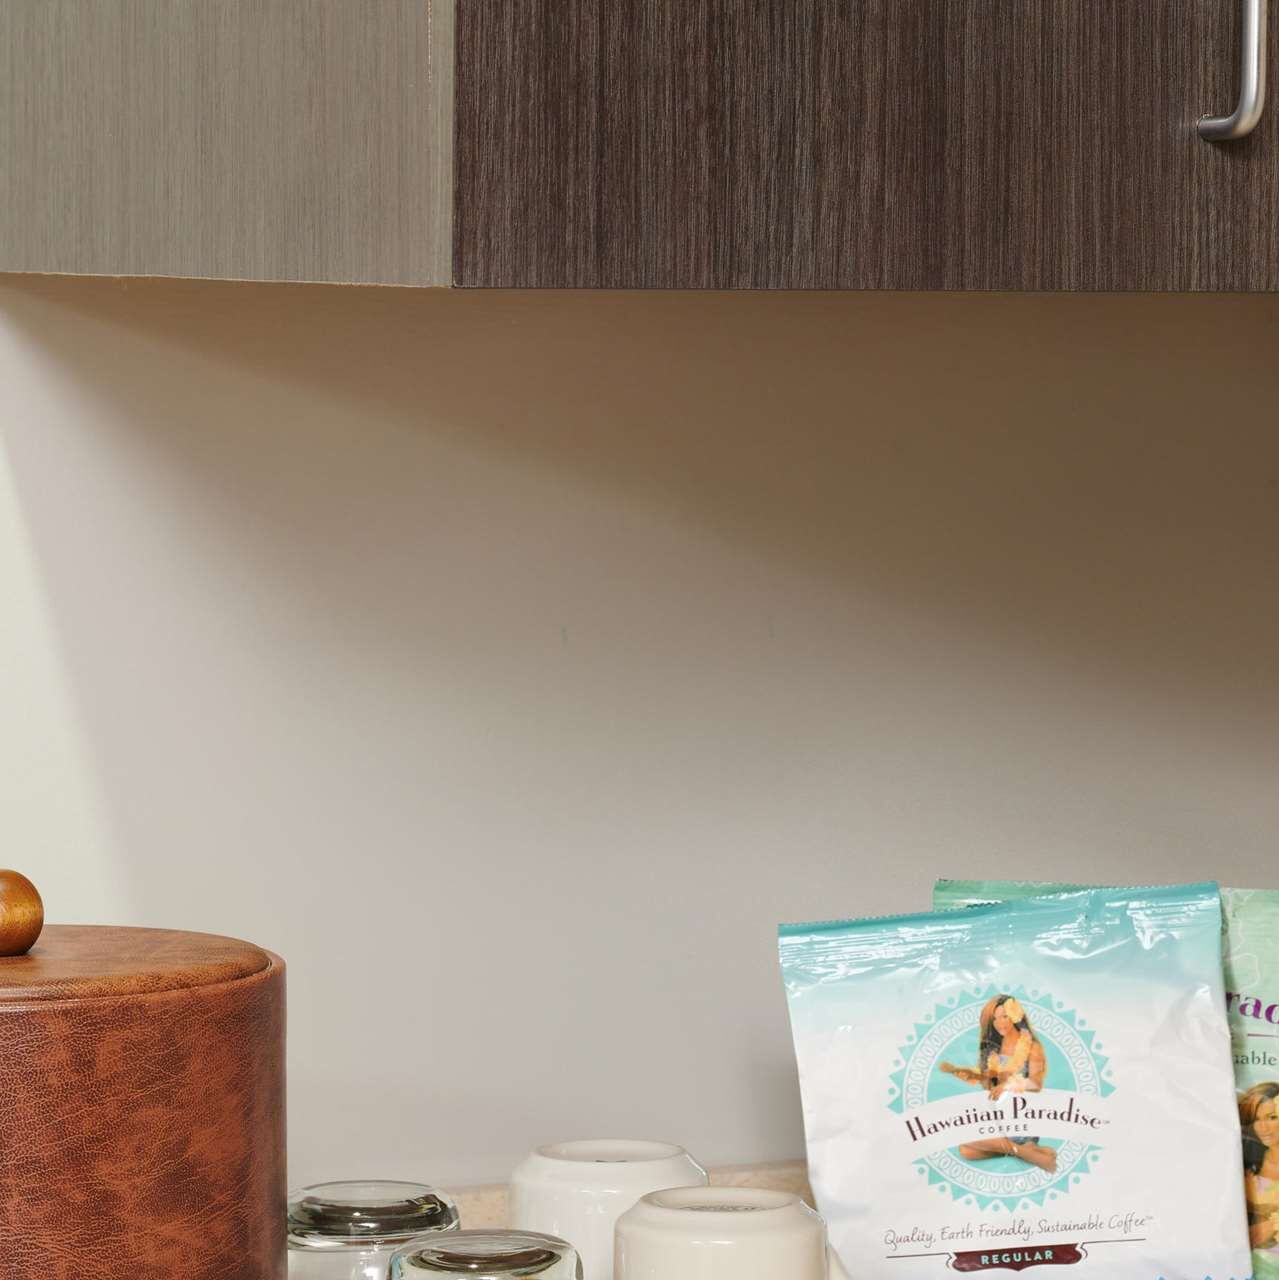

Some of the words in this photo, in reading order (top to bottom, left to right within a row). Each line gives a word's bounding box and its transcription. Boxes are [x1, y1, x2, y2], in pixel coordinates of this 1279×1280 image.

[905, 1108, 1005, 1142] Hawaiian
[978, 1123, 1029, 1135] COFFEE
[884, 1228, 937, 1251] Quality,
[940, 1224, 974, 1242] Earth
[977, 1218, 1034, 1240] Friendly,
[1037, 1214, 1105, 1234] Sustainable
[980, 1249, 1054, 1265] REGULAR
